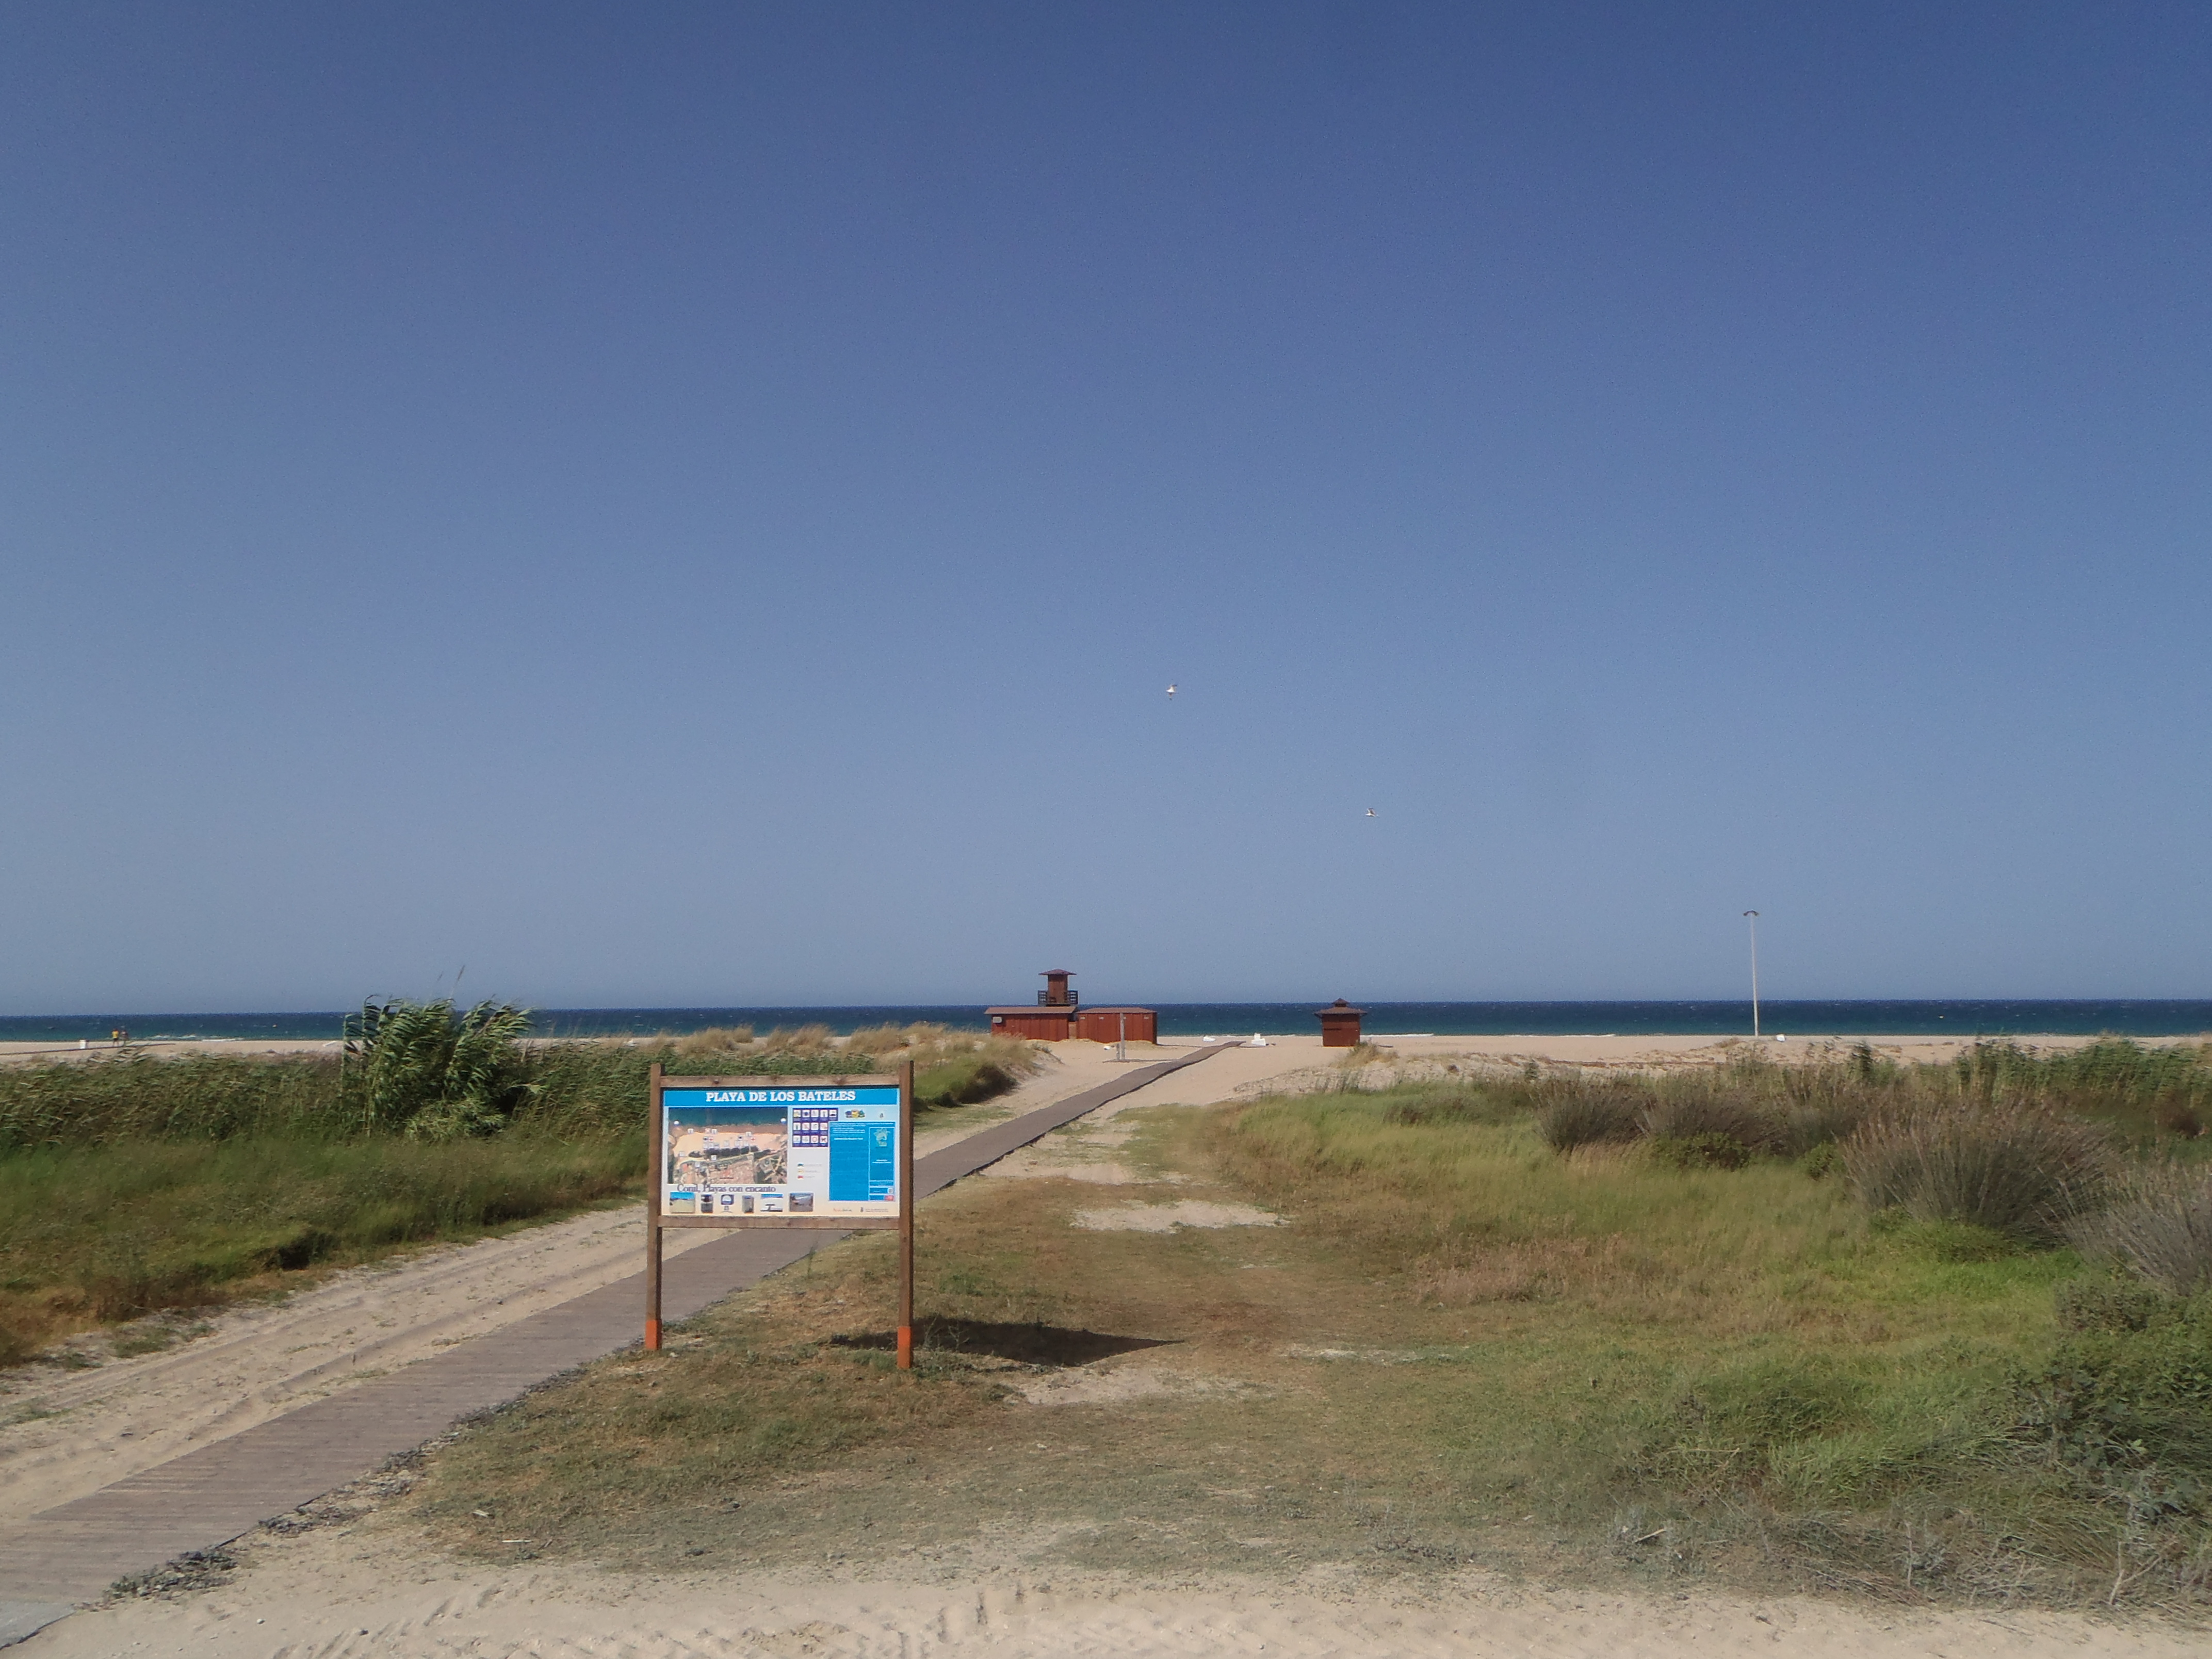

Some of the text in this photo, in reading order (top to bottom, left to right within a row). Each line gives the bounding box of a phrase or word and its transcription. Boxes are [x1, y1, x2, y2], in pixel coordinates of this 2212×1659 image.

[706, 1091, 856, 1102] PLAYA DE LOS BATELES
[702, 1184, 727, 1193] Playas
